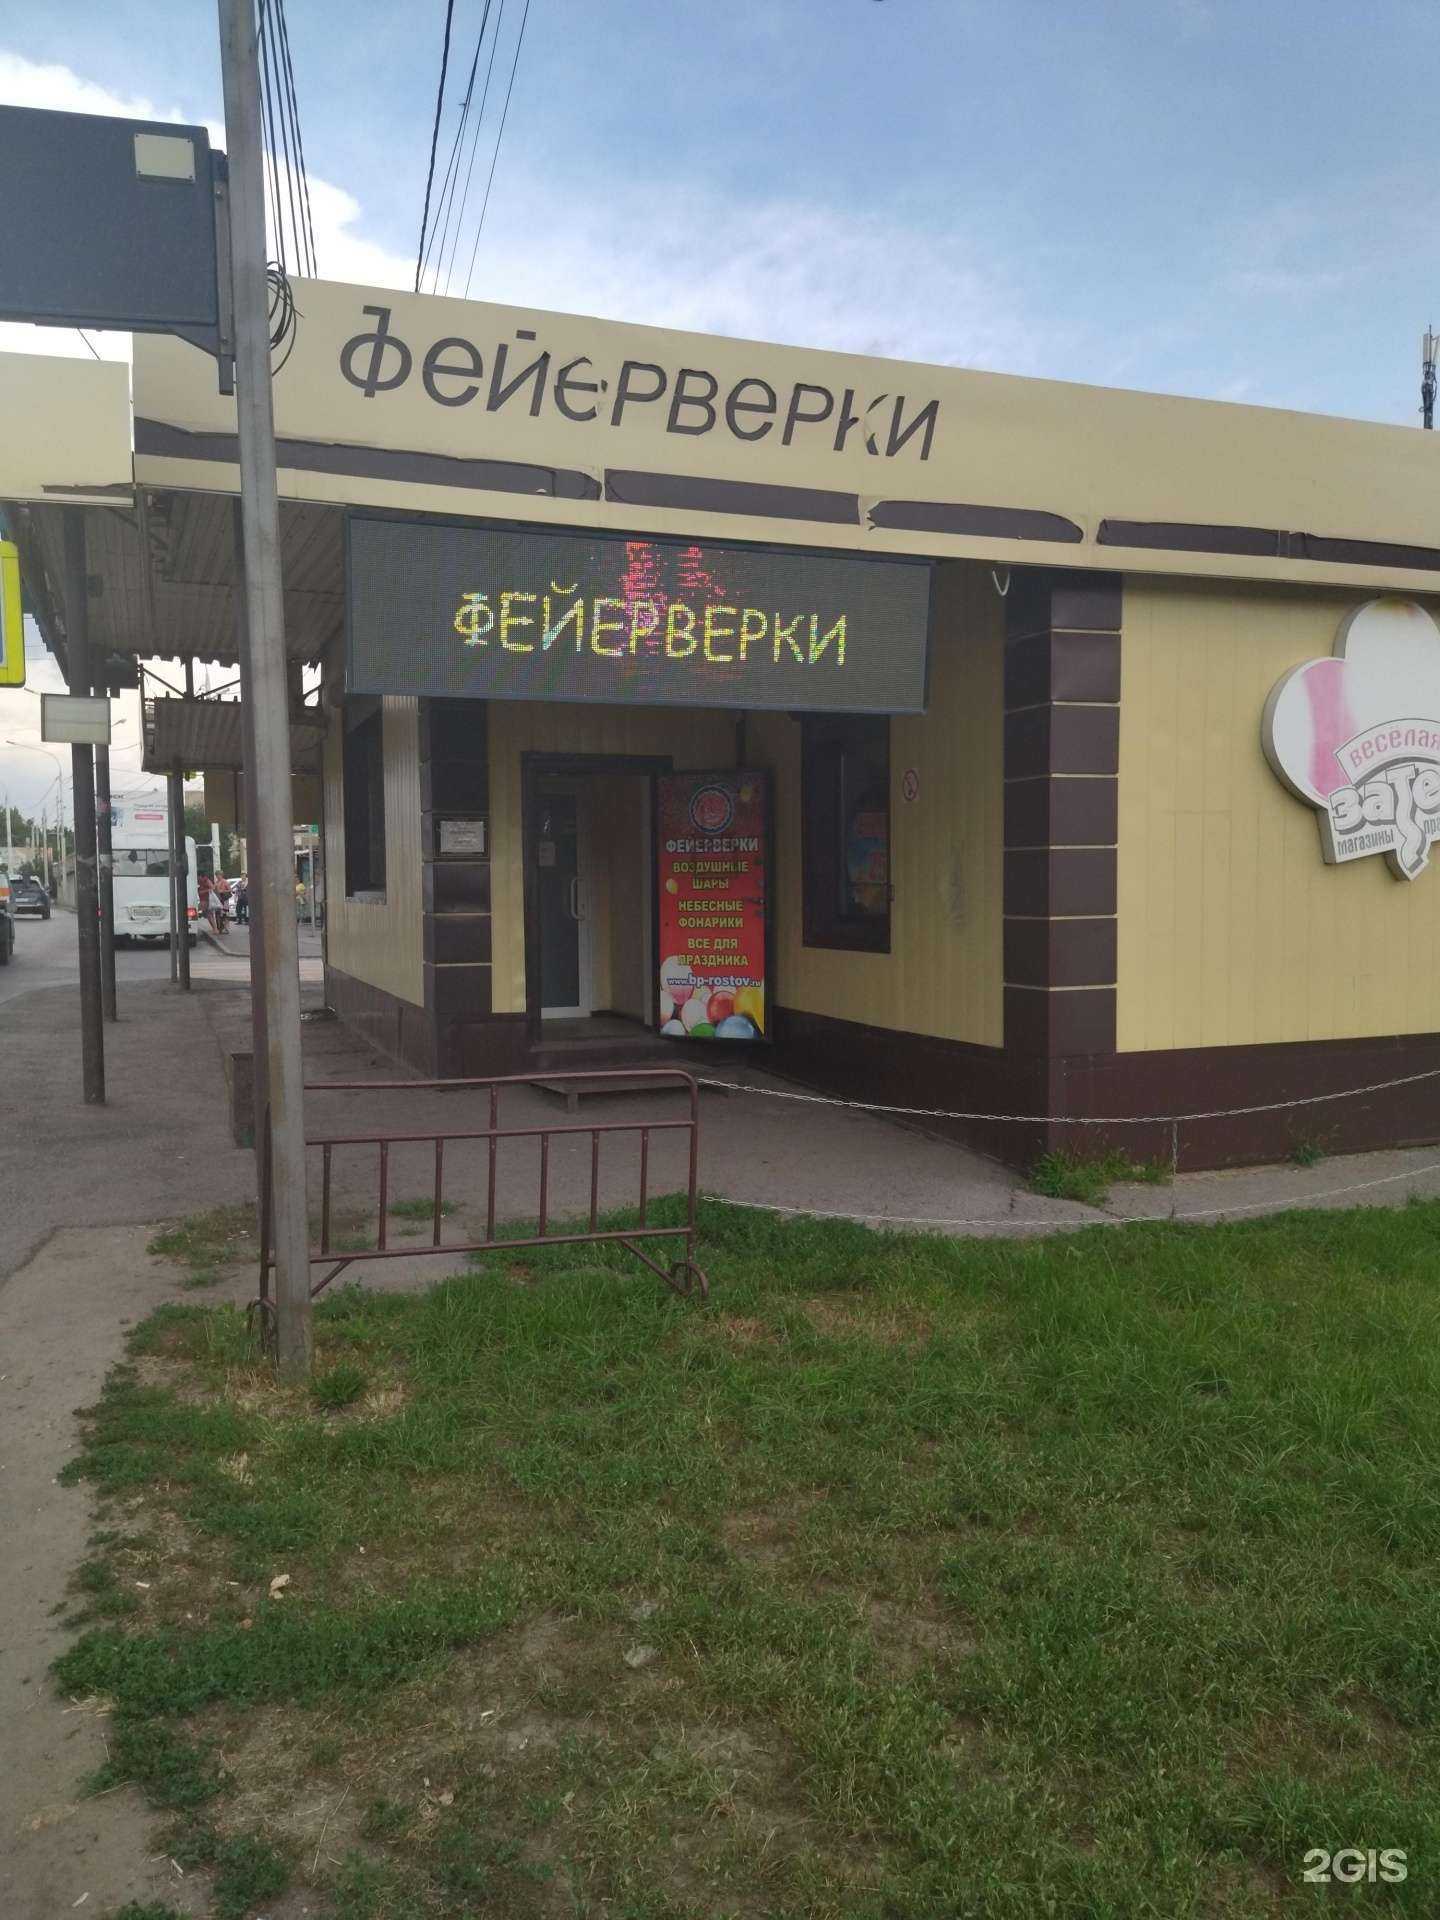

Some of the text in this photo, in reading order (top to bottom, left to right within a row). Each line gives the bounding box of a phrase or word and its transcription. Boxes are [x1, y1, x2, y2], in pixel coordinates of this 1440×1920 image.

[453, 580, 847, 665] ФЕЙЕРВЕРКИ
[665, 837, 759, 853] ФЕЙЕРВЕРКИ
[1337, 829, 1395, 857] магазины
[673, 861, 749, 874] ВОЗДУШНЫЕ
[692, 878, 729, 890] ШАРЫ
[678, 900, 744, 912] НЕБЕСНЫЕ
[678, 917, 744, 928] ФОНАРИКИ
[687, 938, 738, 950] ВСЕ ДЛЯ
[678, 954, 749, 967] ПРАЗДНИКА
[666, 973, 761, 988] www.bp-rostov.ru
